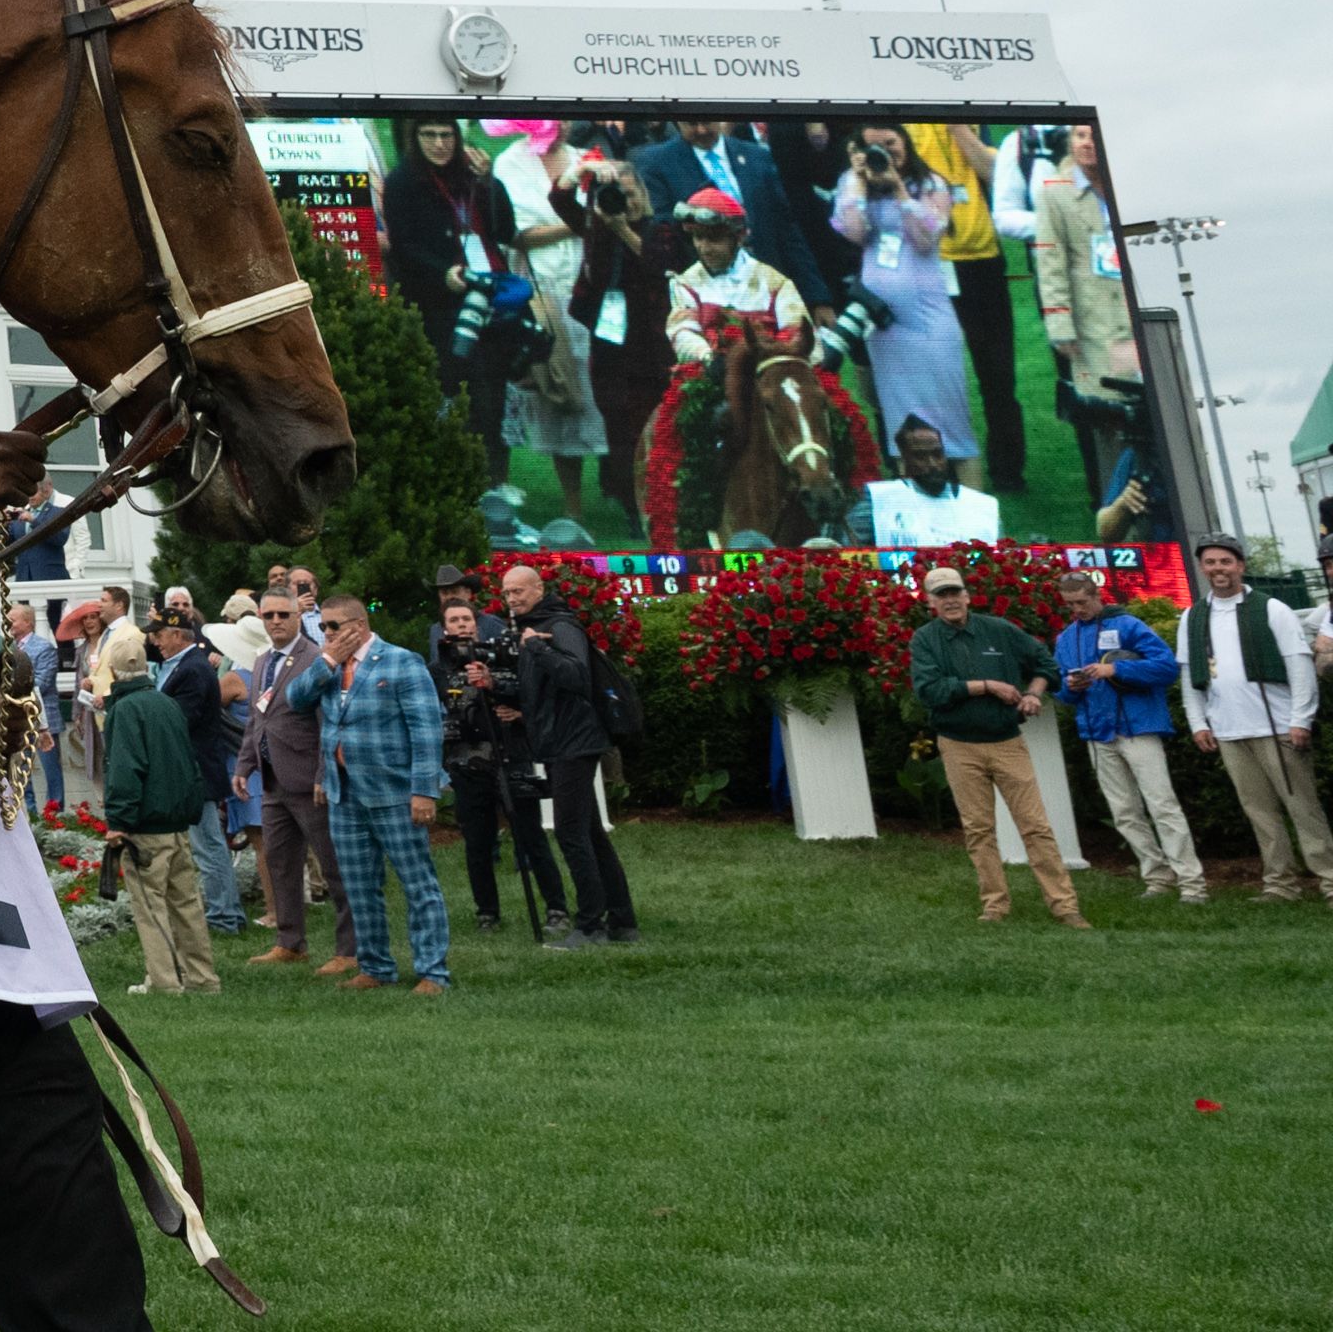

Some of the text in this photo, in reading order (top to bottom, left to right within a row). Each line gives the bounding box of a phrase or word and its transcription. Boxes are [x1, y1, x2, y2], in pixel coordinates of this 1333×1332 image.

[220, 26, 364, 52] ONGINES
[585, 33, 782, 48] OFFICIAL TIMEKEEPER OF
[869, 36, 1034, 61] LONGINES
[574, 56, 800, 78] CHURCHILL DOWNS
[298, 174, 341, 187] RACE
[344, 174, 368, 188] 12
[623, 557, 635, 574] 9
[657, 556, 680, 574] 10
[1077, 550, 1097, 567] 21
[1113, 548, 1138, 567] 22
[619, 577, 643, 594] 31
[664, 577, 678, 594] 6
